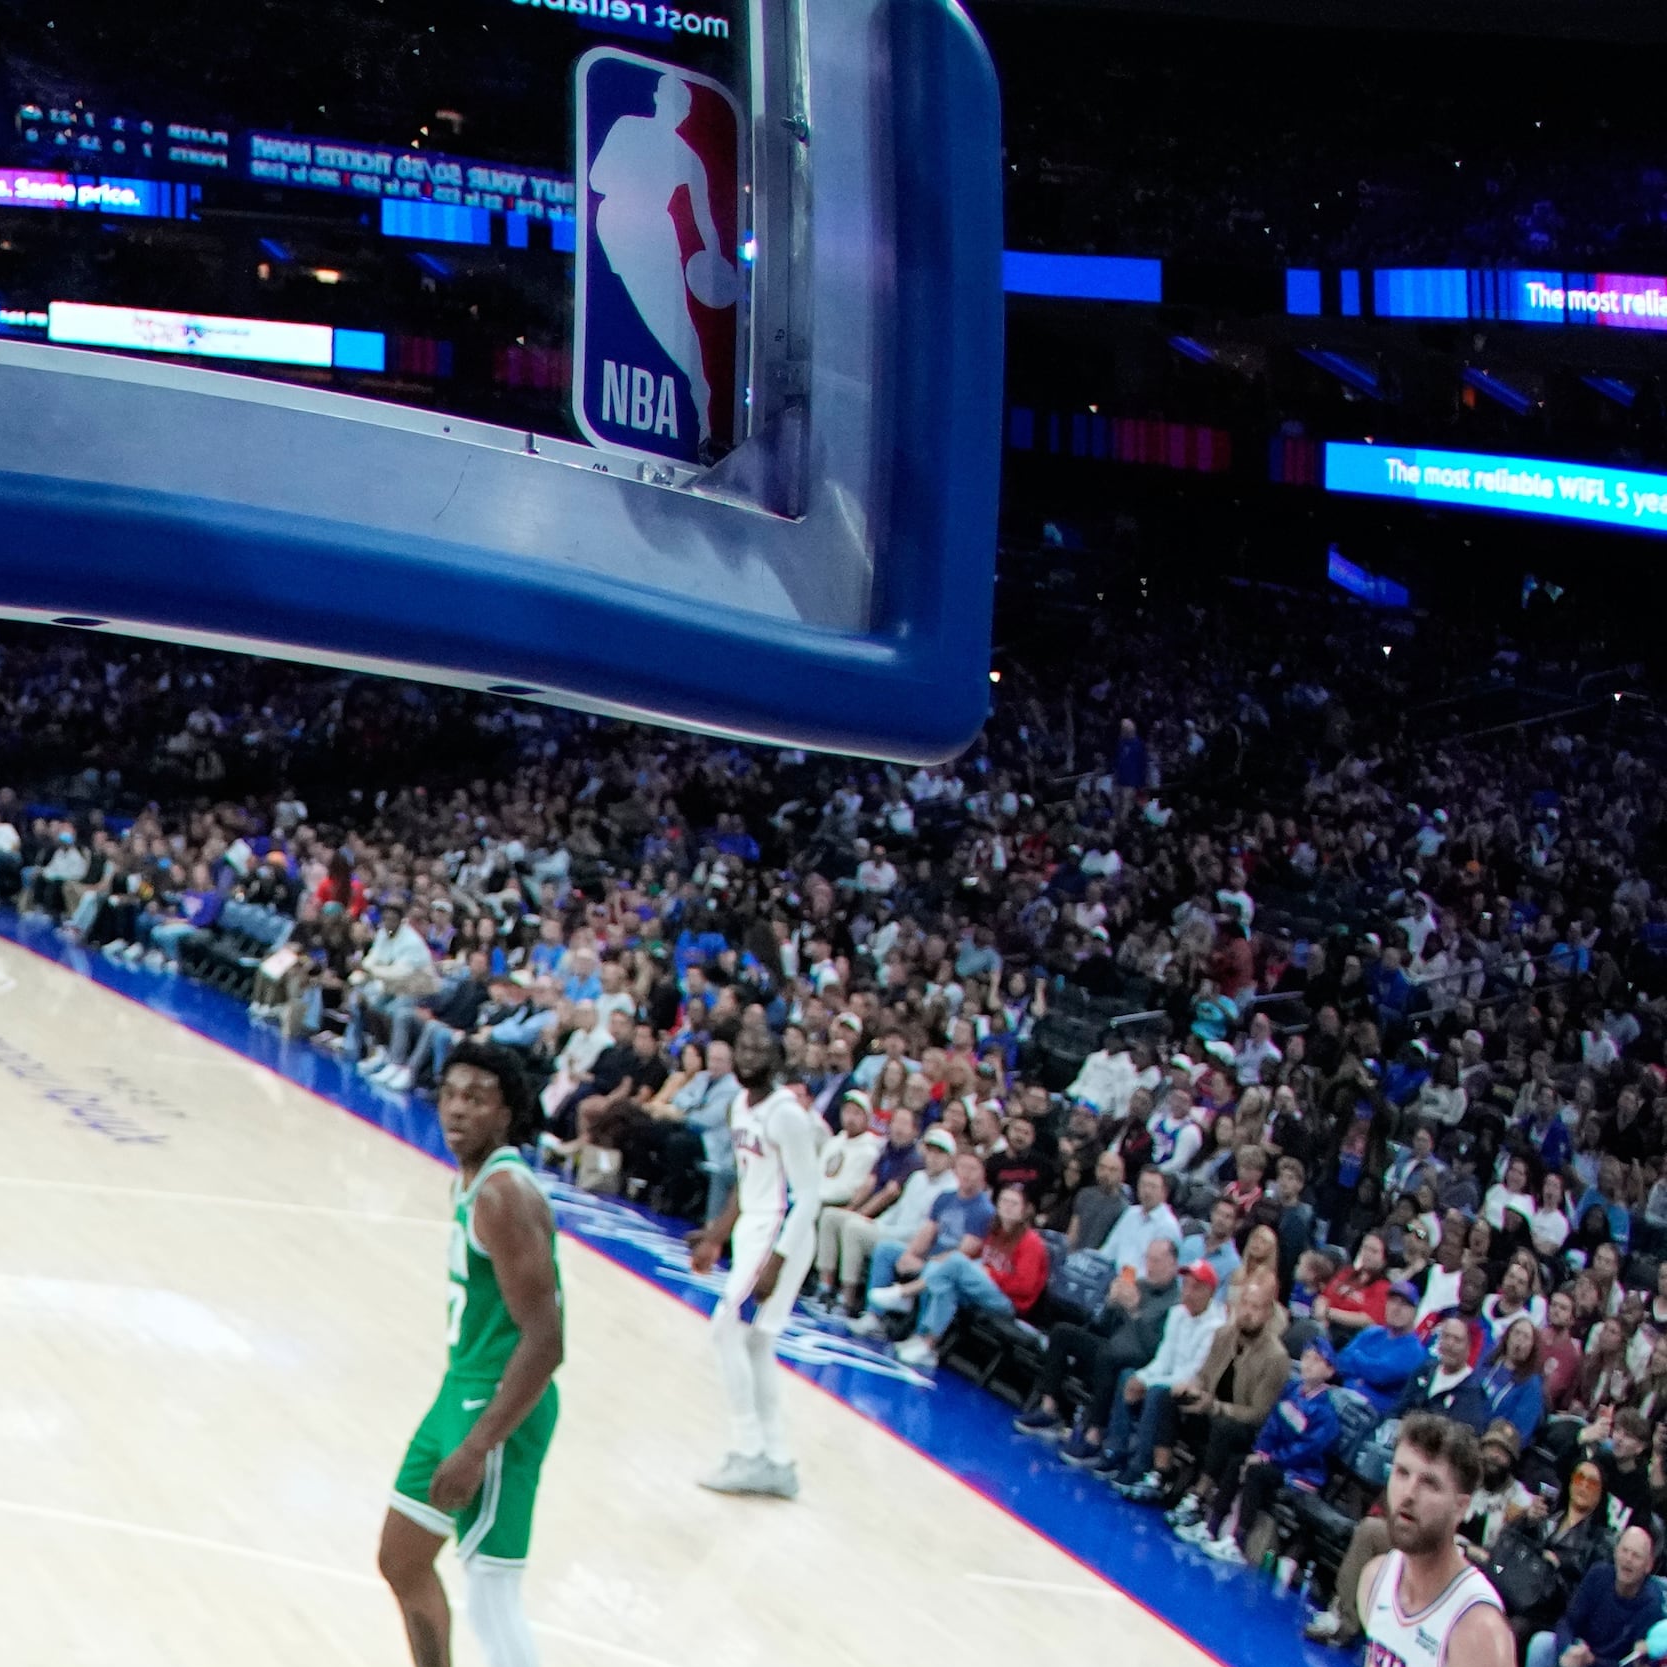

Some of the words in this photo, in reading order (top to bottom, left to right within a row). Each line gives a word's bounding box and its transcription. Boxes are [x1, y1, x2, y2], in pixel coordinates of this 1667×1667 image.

[1526, 281, 1565, 310] The
[1567, 289, 1620, 314] most
[1622, 288, 1667, 318] relia
[601, 359, 679, 439] NBA
[1384, 457, 1420, 485] The
[1423, 465, 1471, 490] most
[1473, 467, 1555, 499] reliable
[1615, 482, 1629, 509] 5
